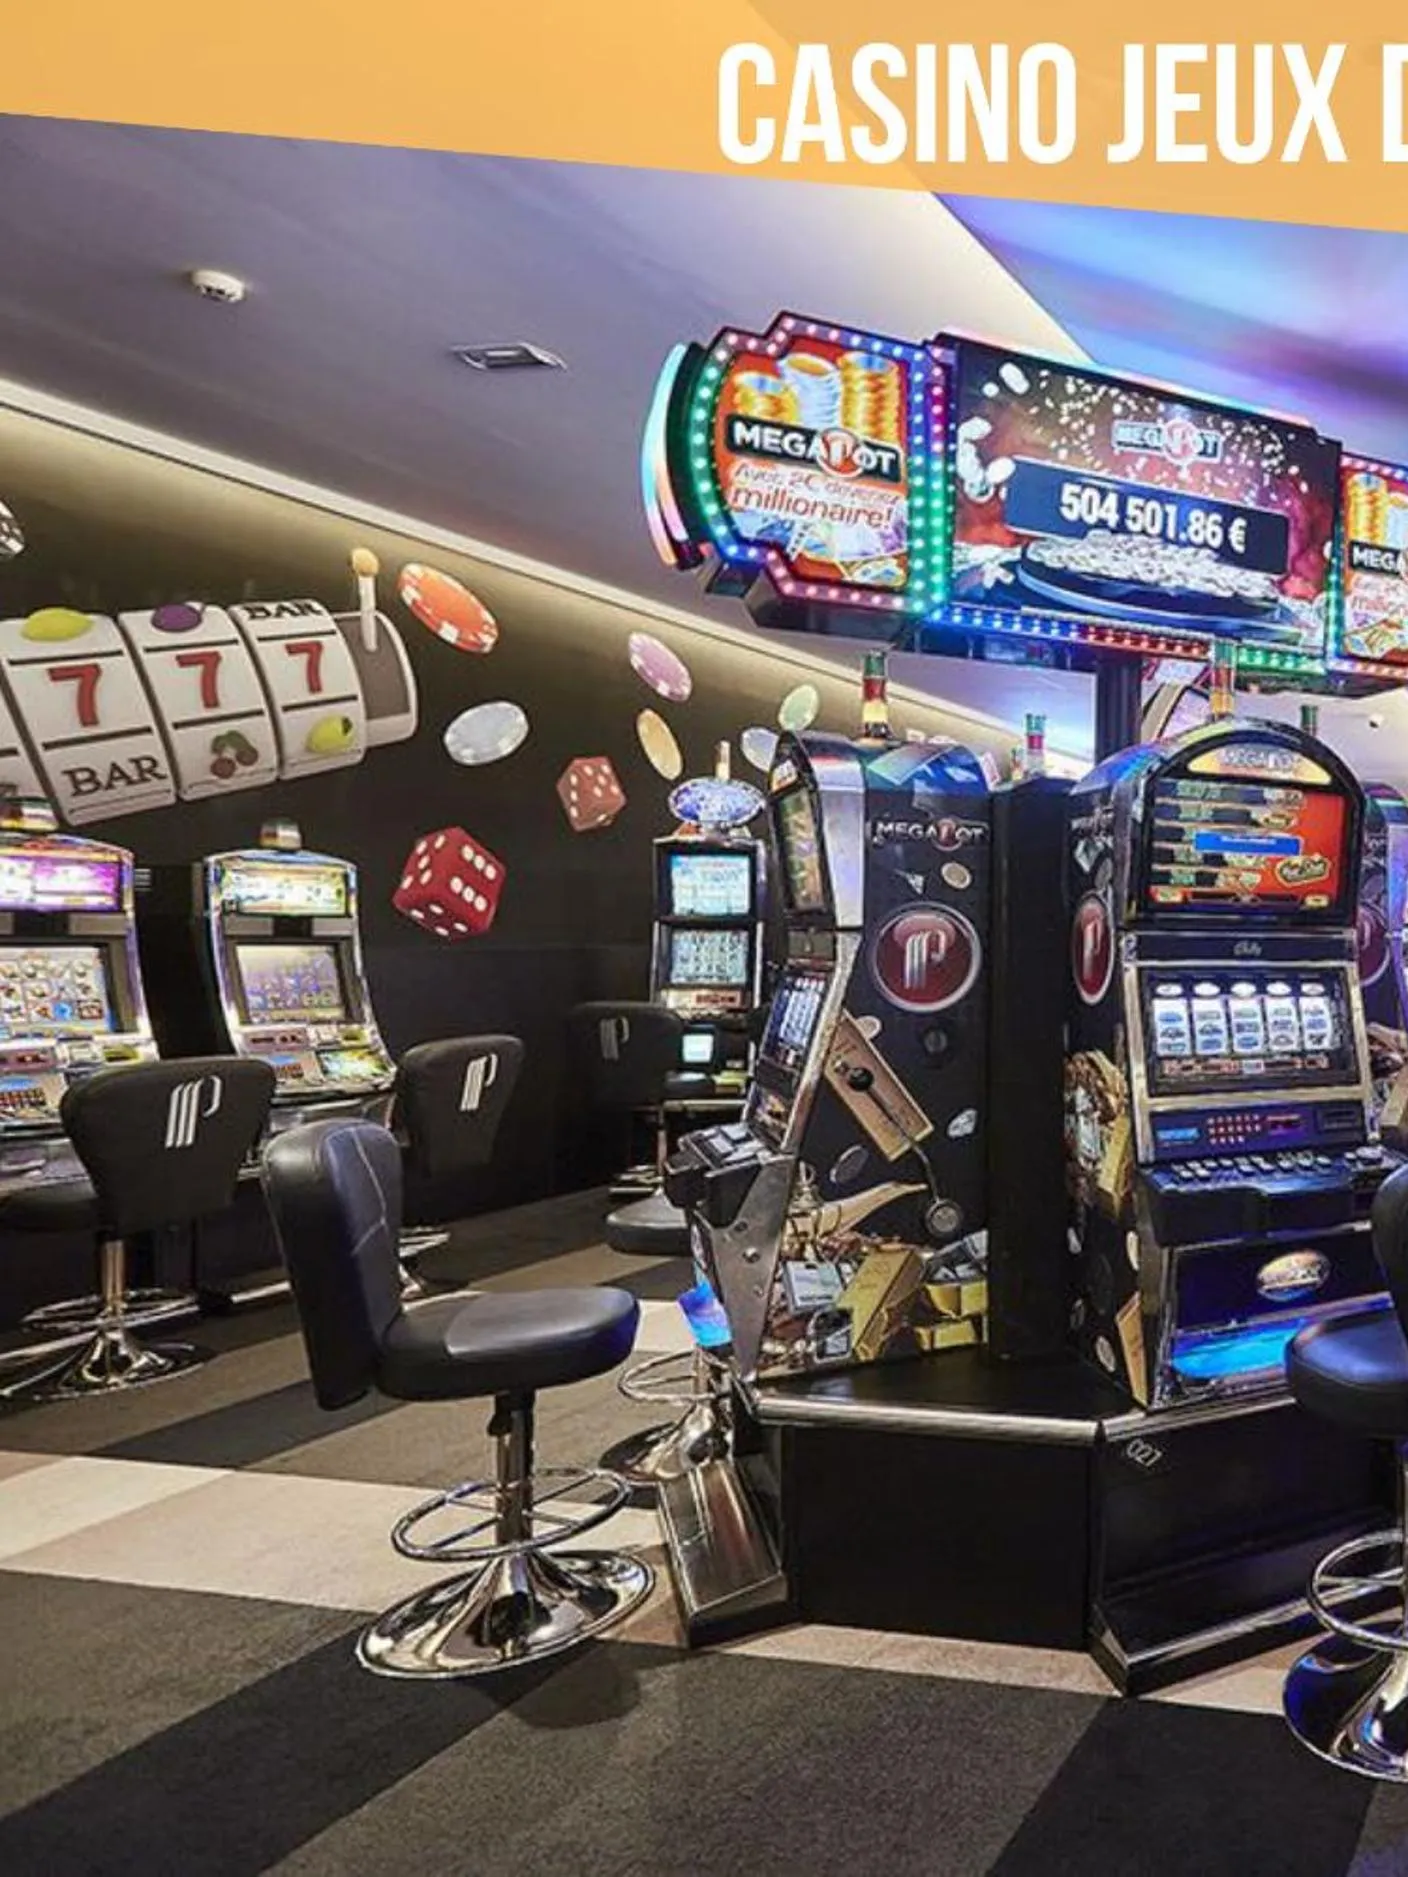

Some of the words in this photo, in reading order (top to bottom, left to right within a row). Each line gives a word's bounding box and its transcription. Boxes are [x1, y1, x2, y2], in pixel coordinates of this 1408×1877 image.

[1060, 482, 1119, 529] 504
[1125, 496, 1224, 549] 501.86
[1228, 518, 1247, 554] €
[48, 663, 102, 727] 7
[175, 651, 221, 709] 7
[285, 641, 323, 694] 7
[62, 755, 167, 796] BAR
